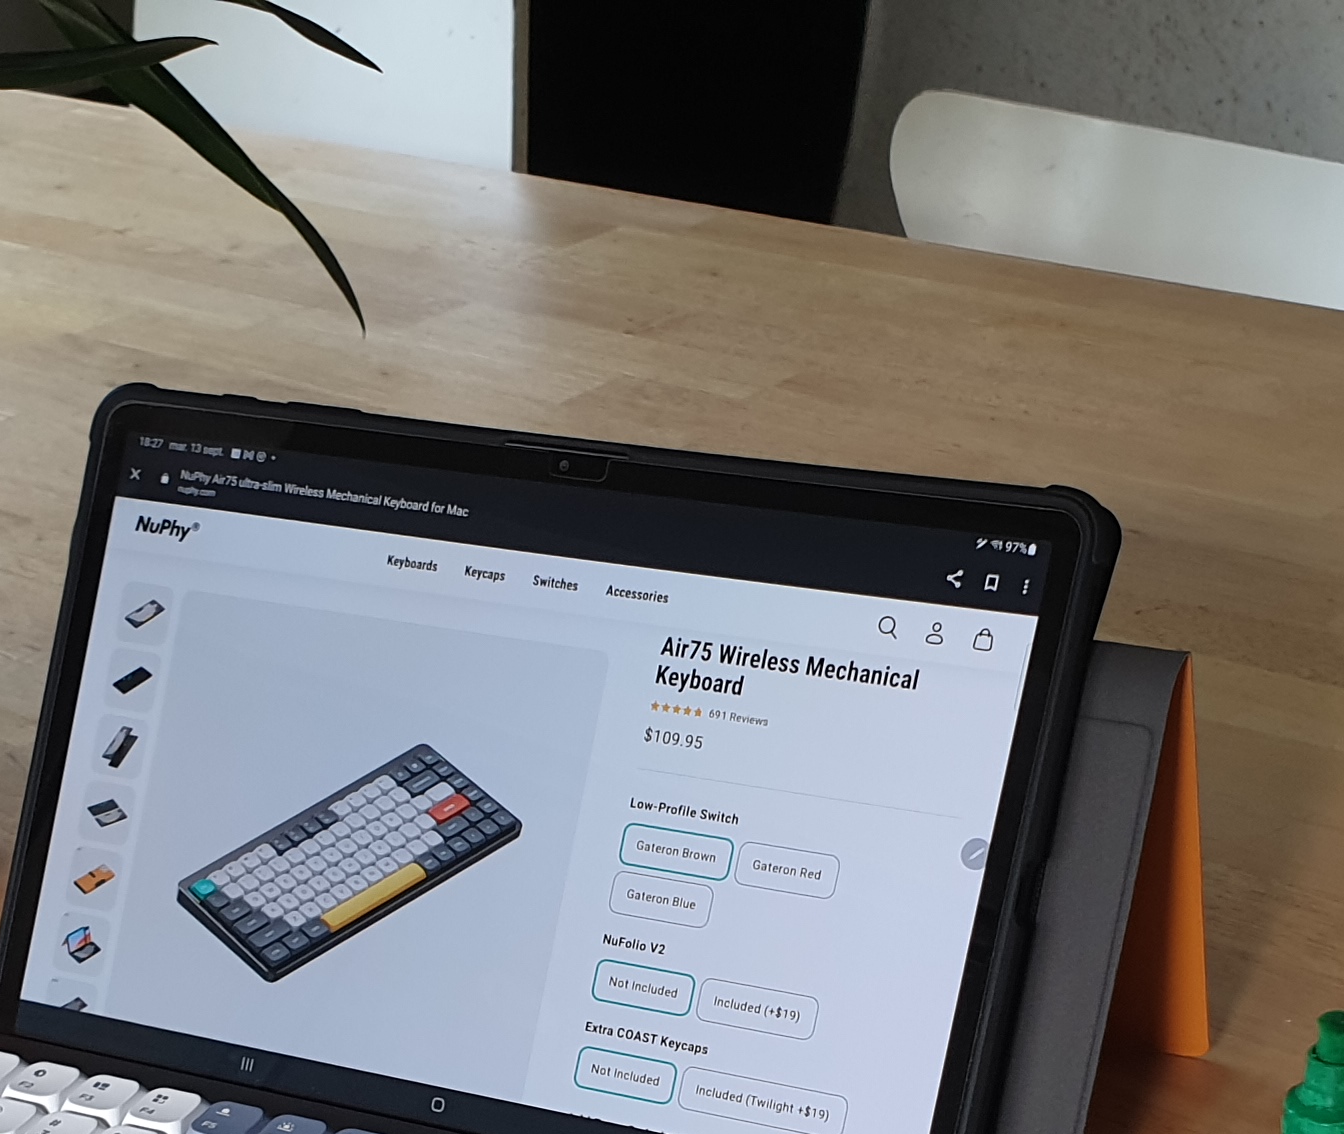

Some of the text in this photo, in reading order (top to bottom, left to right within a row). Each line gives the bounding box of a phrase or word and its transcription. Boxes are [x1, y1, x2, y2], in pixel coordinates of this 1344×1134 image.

[180, 470, 469, 518] NuPhy Air75 ultra-slim Wireless Mechanical Keyboard for Mac
[1003, 540, 1027, 556] 97%
[386, 554, 670, 604] Keyboards Keycaps Switches Accessories
[660, 636, 921, 692] Air75 Wireless Mechanical
[654, 663, 745, 698] Keyboard
[708, 707, 769, 727] 691 Reviews
[642, 726, 704, 752] $109.95
[629, 796, 740, 826] Low-Profile Switch
[635, 839, 717, 864] Gateron Brown
[751, 859, 822, 881] Gateron Red
[626, 887, 697, 911] Gateron Blue
[602, 933, 667, 956] NuFolio V2
[608, 975, 679, 1000] Not Included
[713, 995, 802, 1024] Included (+$19)
[584, 1021, 709, 1057] Extra COAST Keycaps
[590, 1063, 661, 1087] Not Included
[695, 1083, 831, 1124] Included (Twilight +$19)
[49, 1119, 61, 1127] #
